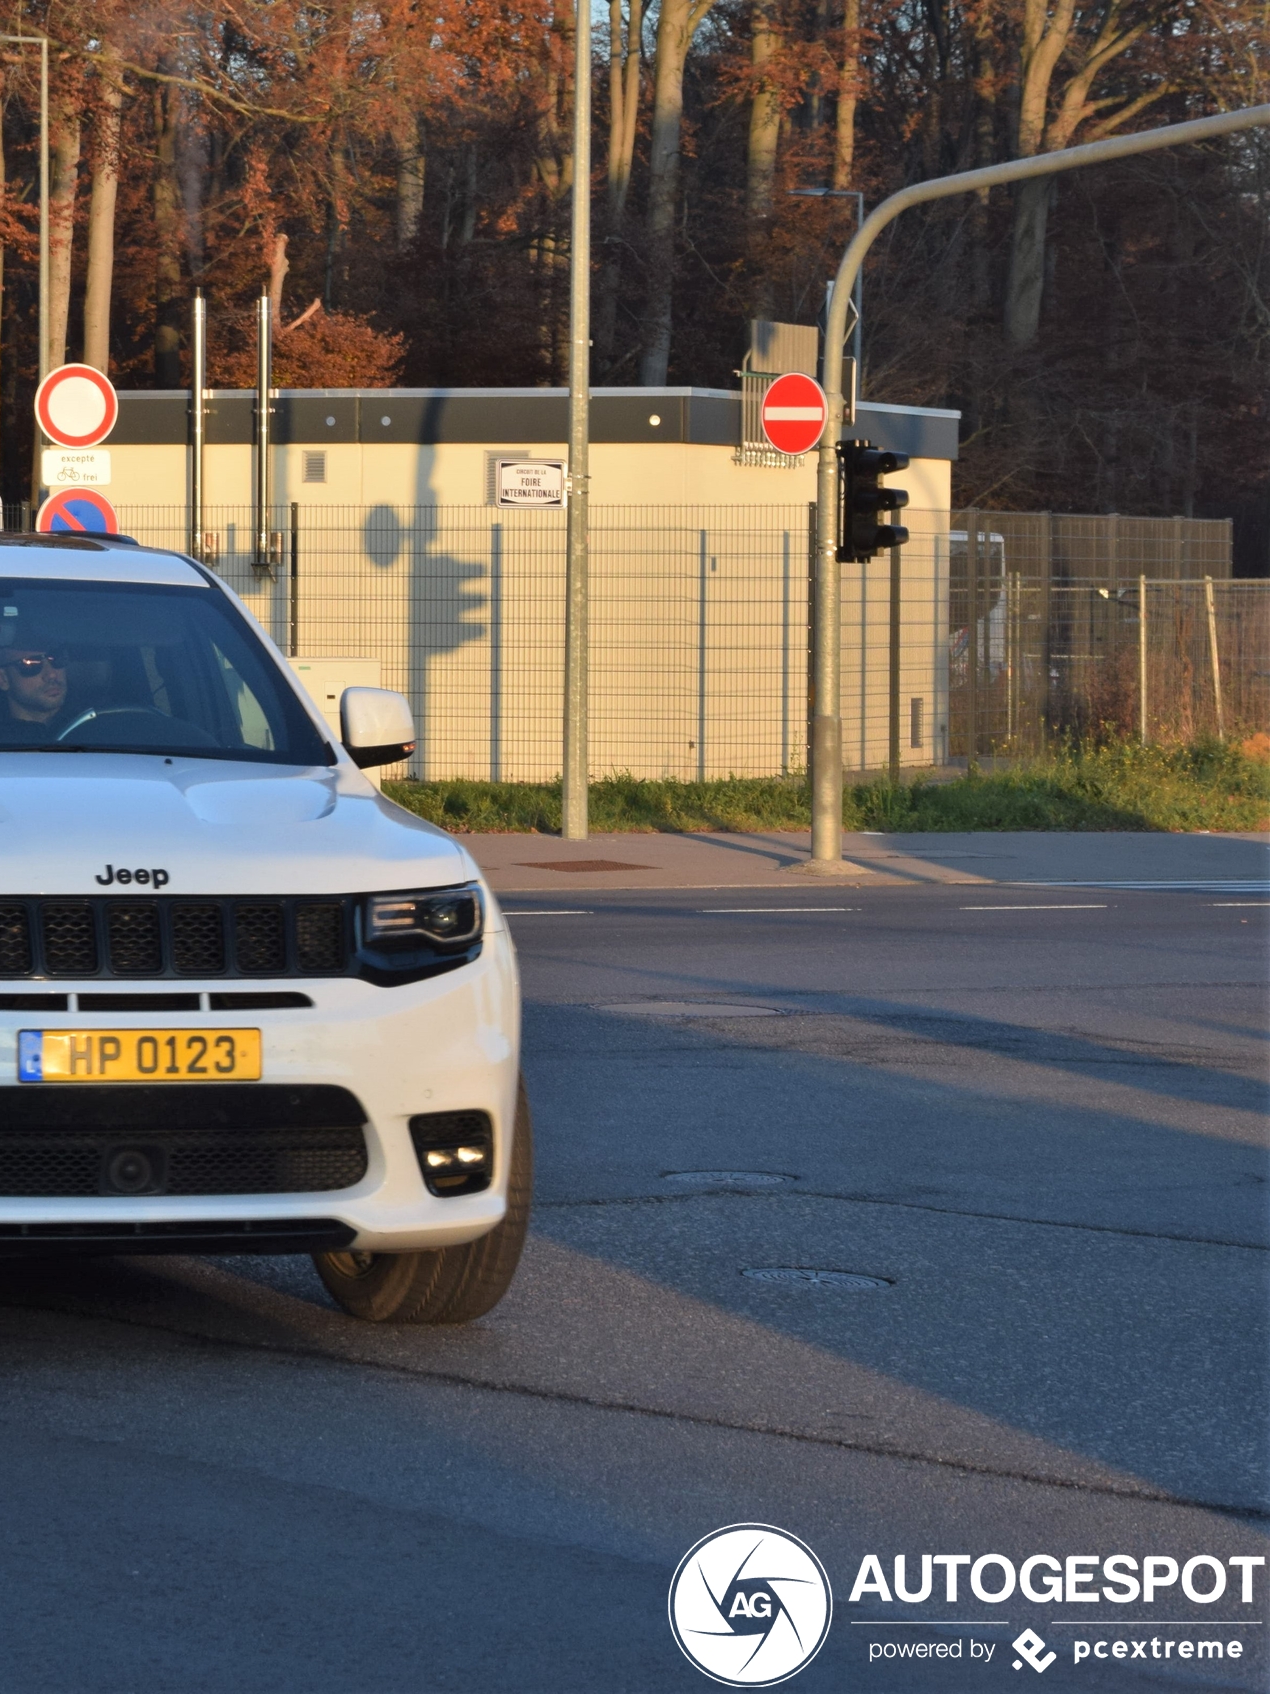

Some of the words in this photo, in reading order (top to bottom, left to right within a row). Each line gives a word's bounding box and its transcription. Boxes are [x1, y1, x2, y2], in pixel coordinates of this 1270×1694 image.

[61, 455, 95, 464] excepté
[83, 473, 98, 481] frei
[521, 478, 541, 487] FOIRE
[502, 489, 560, 498] INTERNATIONALE
[95, 865, 169, 889] Jeep
[70, 1036, 121, 1075] HP
[137, 1035, 235, 1074] 0123
[26, 1061, 34, 1073] L
